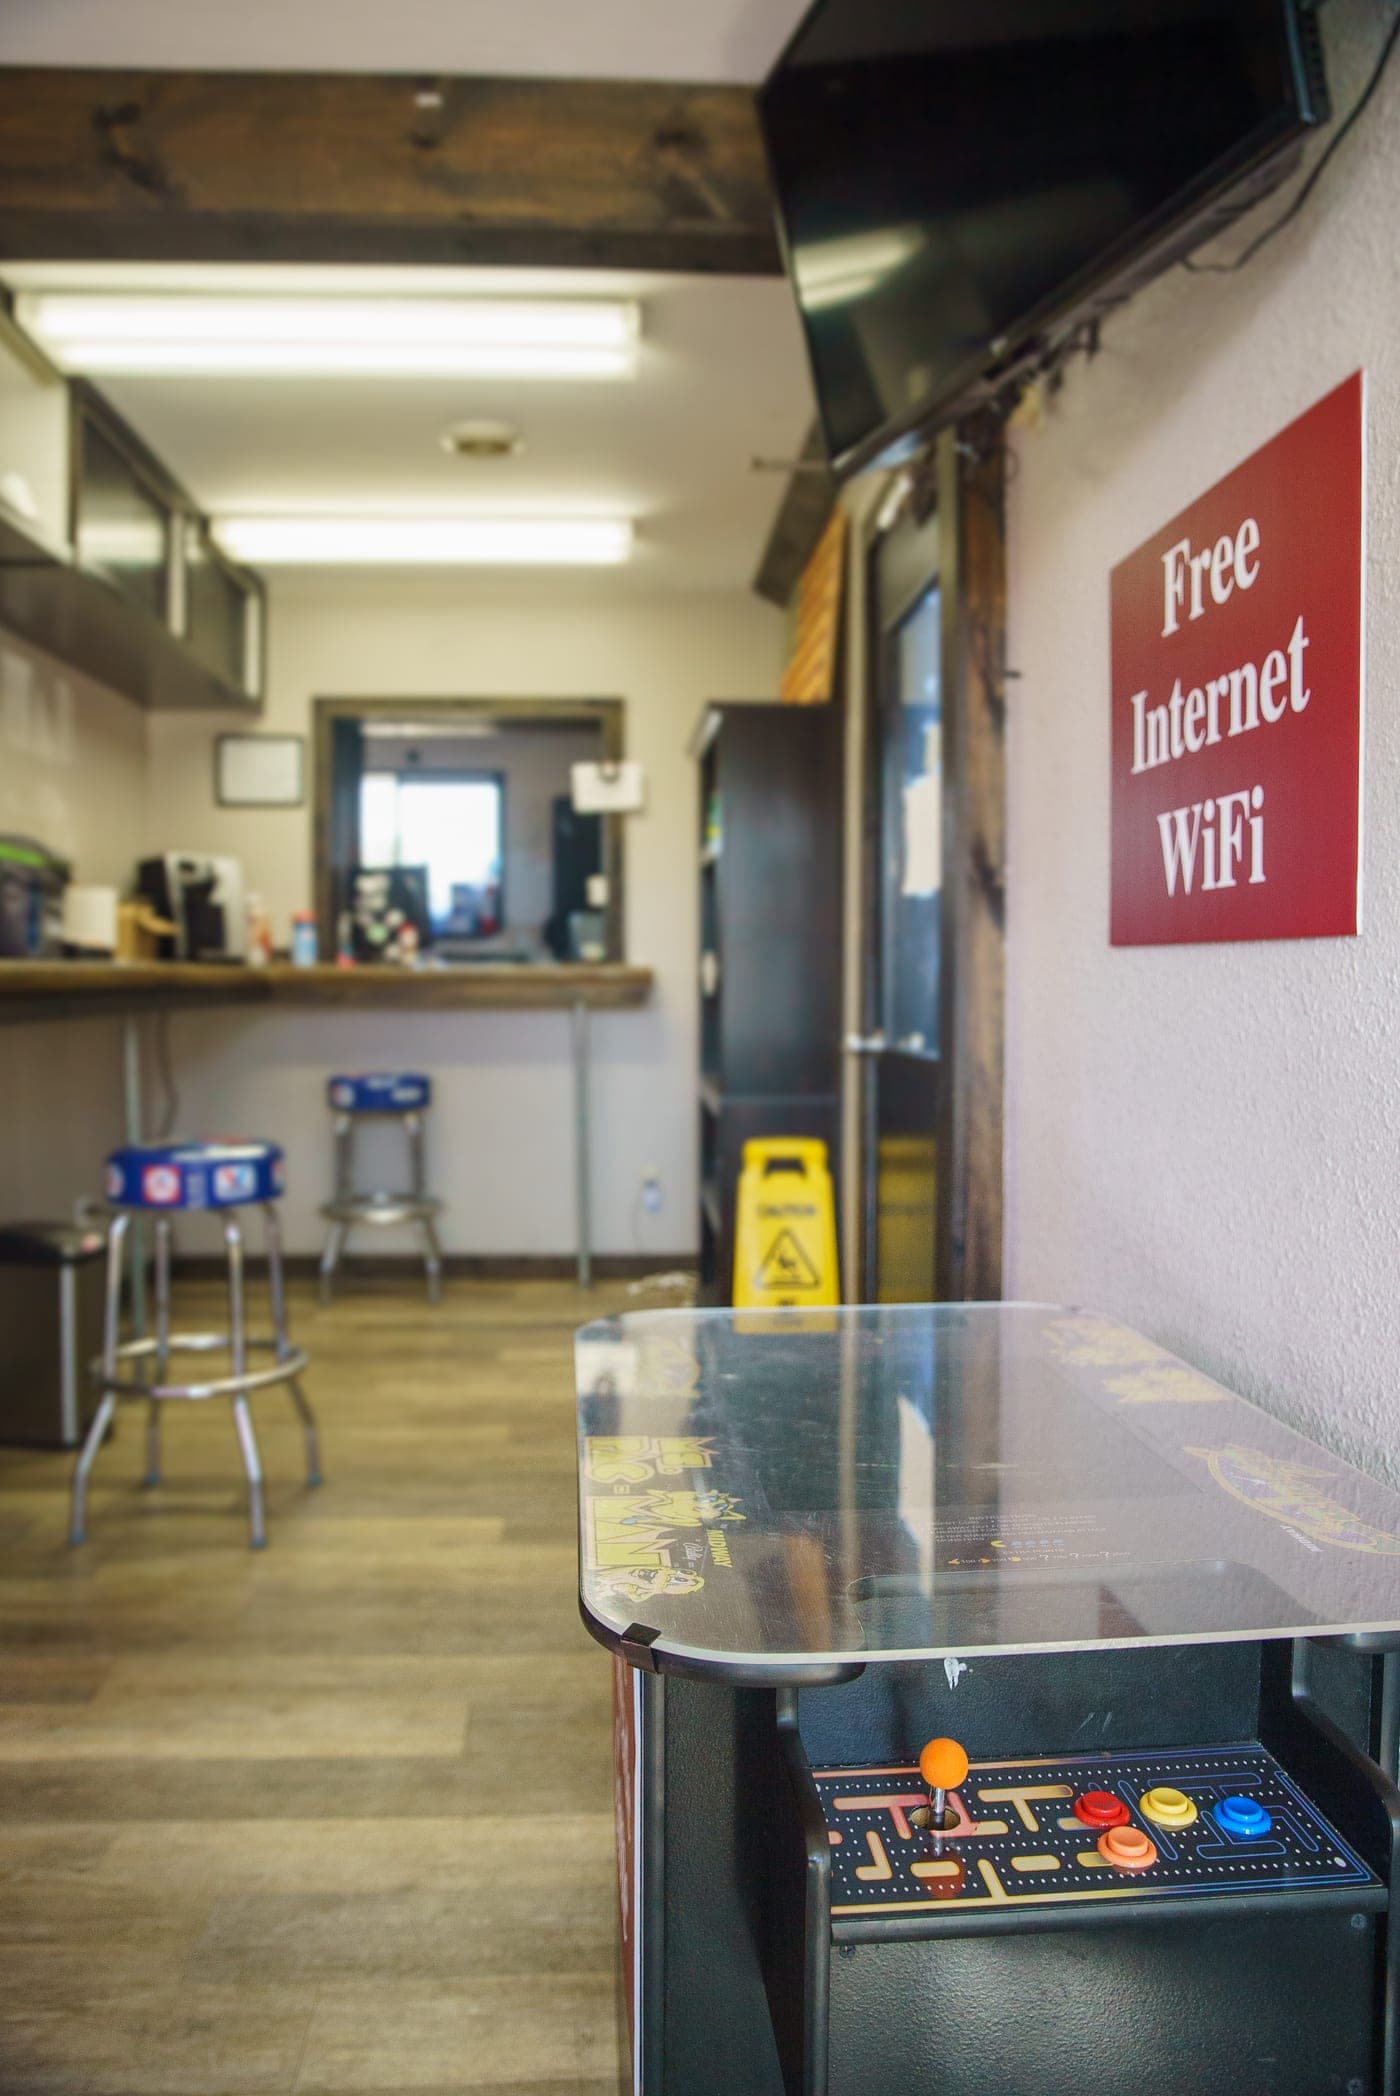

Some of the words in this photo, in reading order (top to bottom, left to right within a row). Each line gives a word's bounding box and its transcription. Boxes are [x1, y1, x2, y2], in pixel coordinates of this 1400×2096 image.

[1161, 517, 1261, 638] Free
[1130, 614, 1311, 775] Internet
[1157, 784, 1266, 897] WiFi
[706, 1529, 734, 1568] MIDWAY
